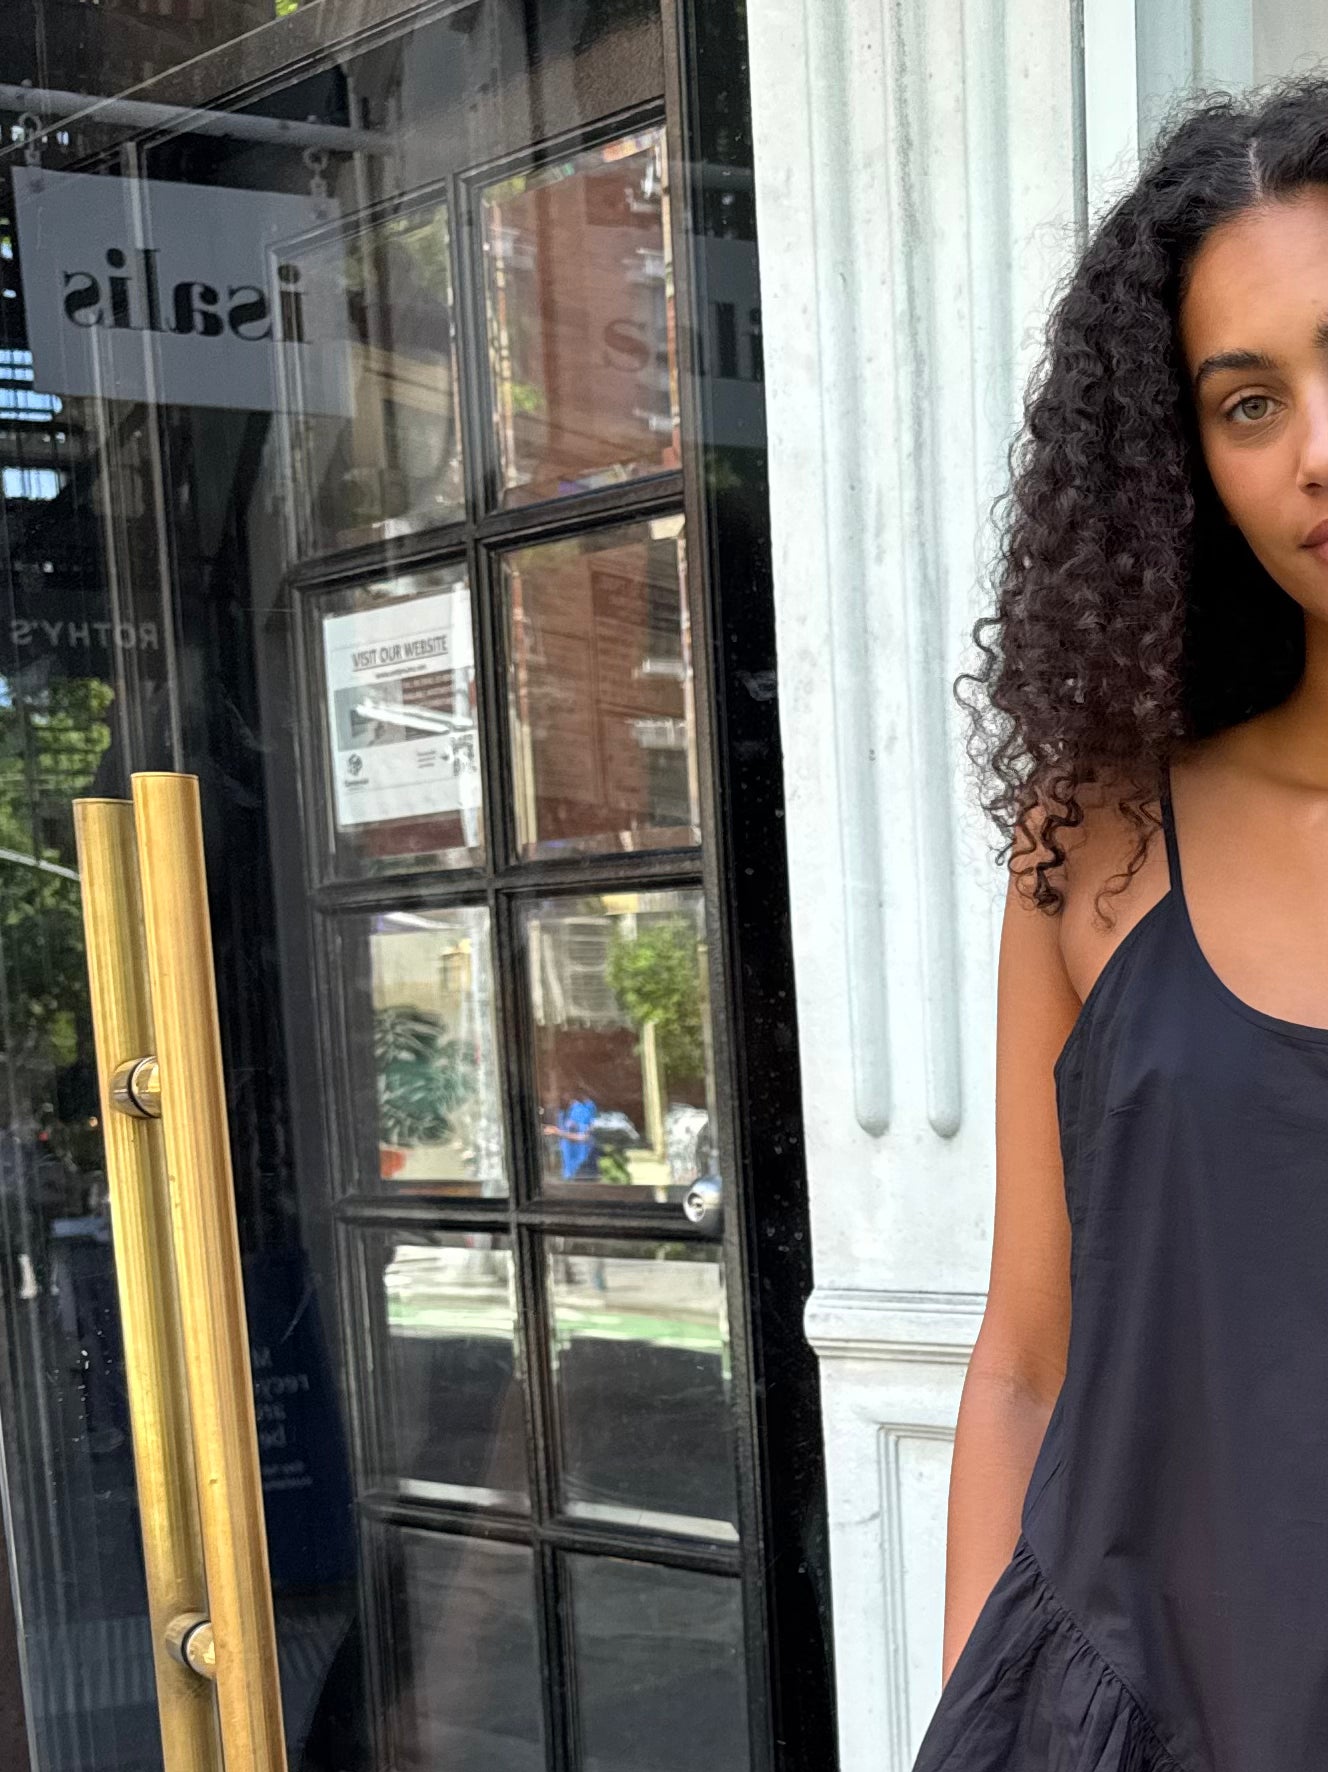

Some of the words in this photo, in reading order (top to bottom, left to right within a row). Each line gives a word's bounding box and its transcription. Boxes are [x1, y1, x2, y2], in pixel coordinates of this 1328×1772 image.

[352, 648, 377, 668] VISIT
[379, 643, 402, 664] OUR
[404, 634, 449, 657] WEBSITE
